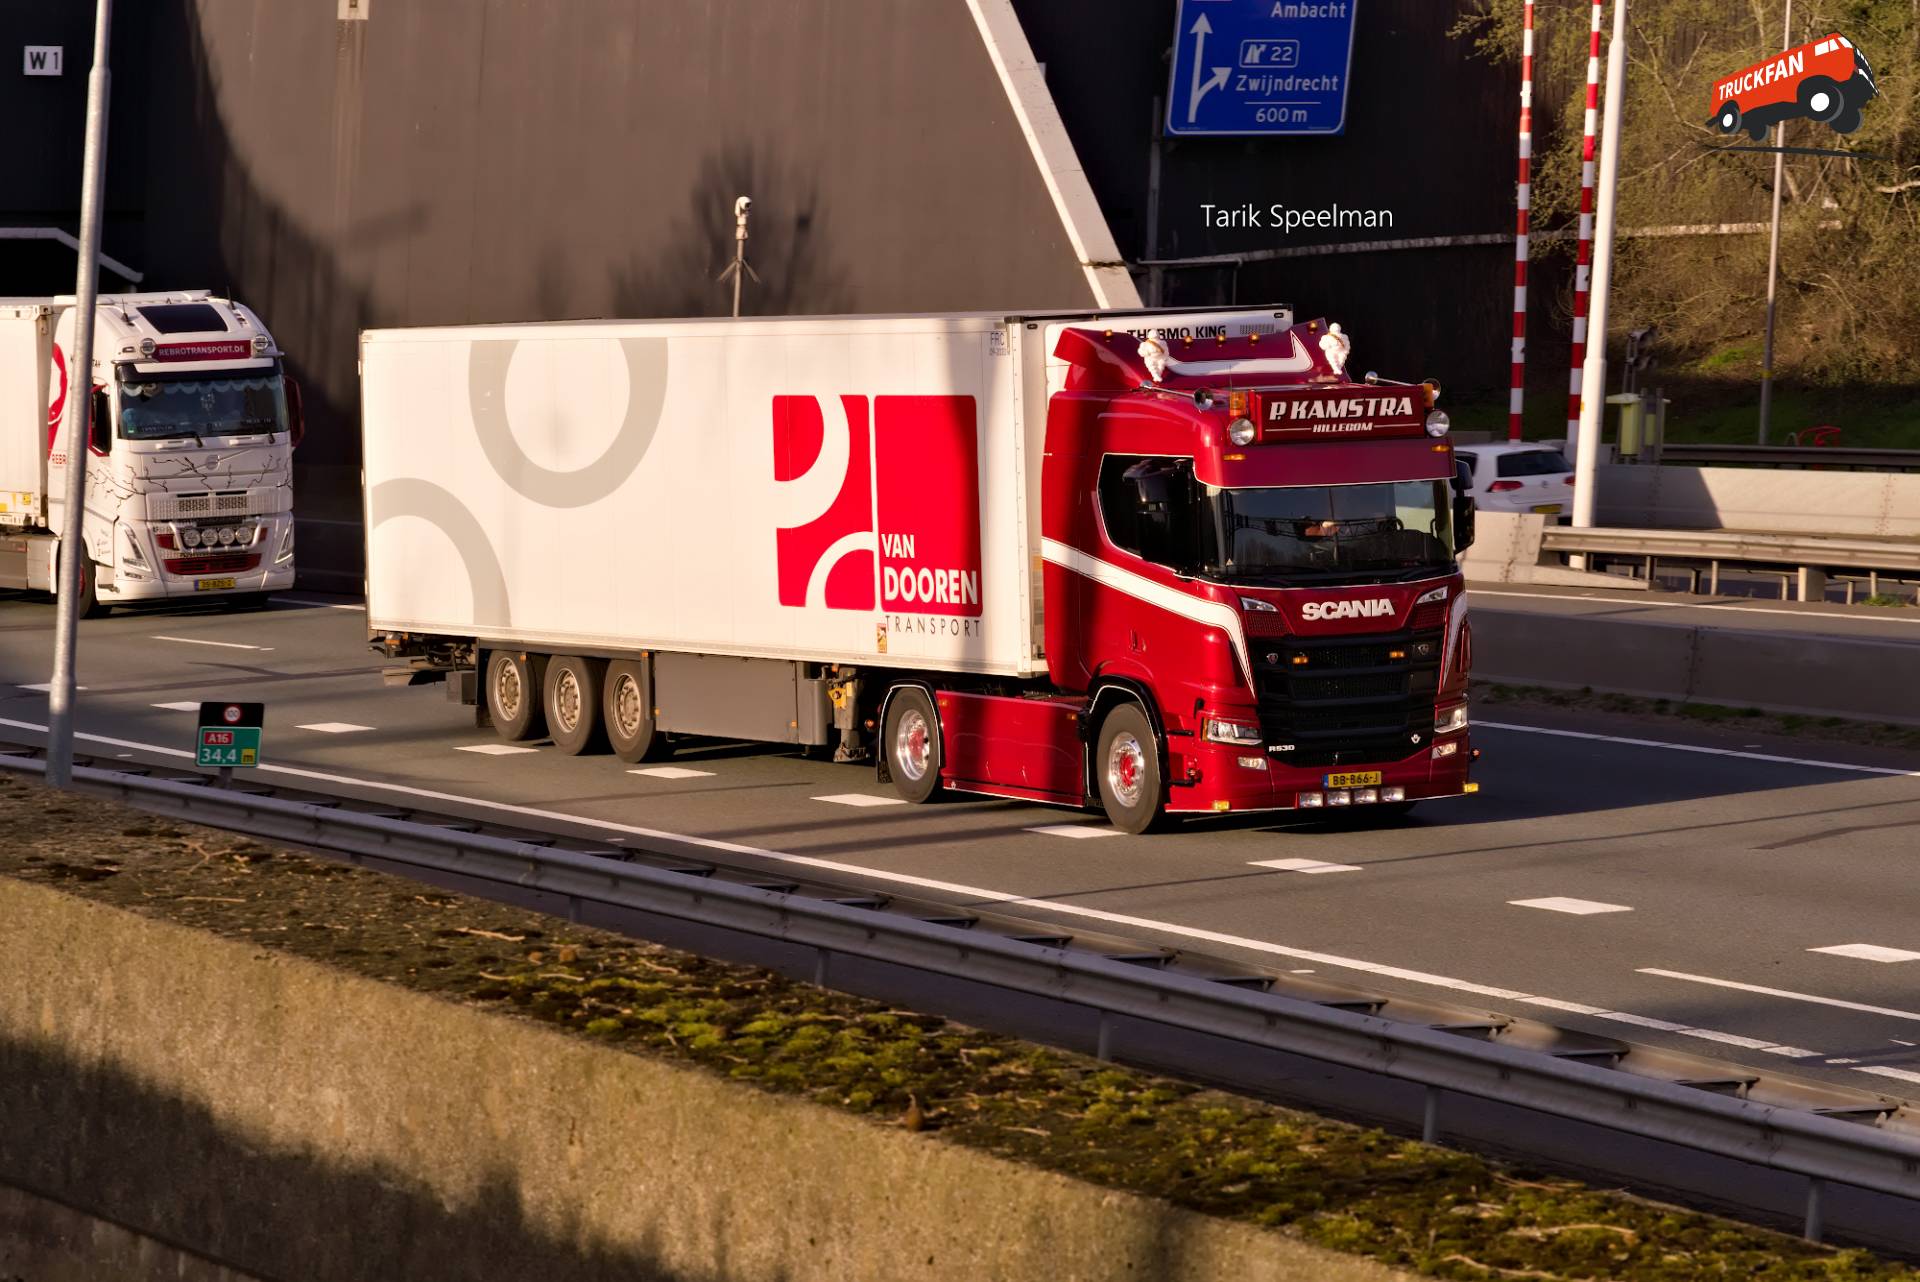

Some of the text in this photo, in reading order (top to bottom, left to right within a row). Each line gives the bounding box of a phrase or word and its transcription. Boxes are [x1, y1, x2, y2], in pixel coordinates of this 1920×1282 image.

[1271, 1, 1346, 18] Ambacht
[29, 51, 47, 70] W
[1270, 46, 1293, 62] 22
[1236, 75, 1339, 97] Zwijndrecht
[1255, 108, 1289, 123] 600
[1127, 325, 1226, 340] THRMO KING
[1290, 397, 1414, 420] KAMSTRA
[1313, 422, 1373, 433] HILLEGOM
[881, 533, 915, 559] VAN
[883, 566, 978, 605] DOOREN
[1302, 598, 1395, 621] SCANIA
[885, 615, 980, 637] TRANSPORT
